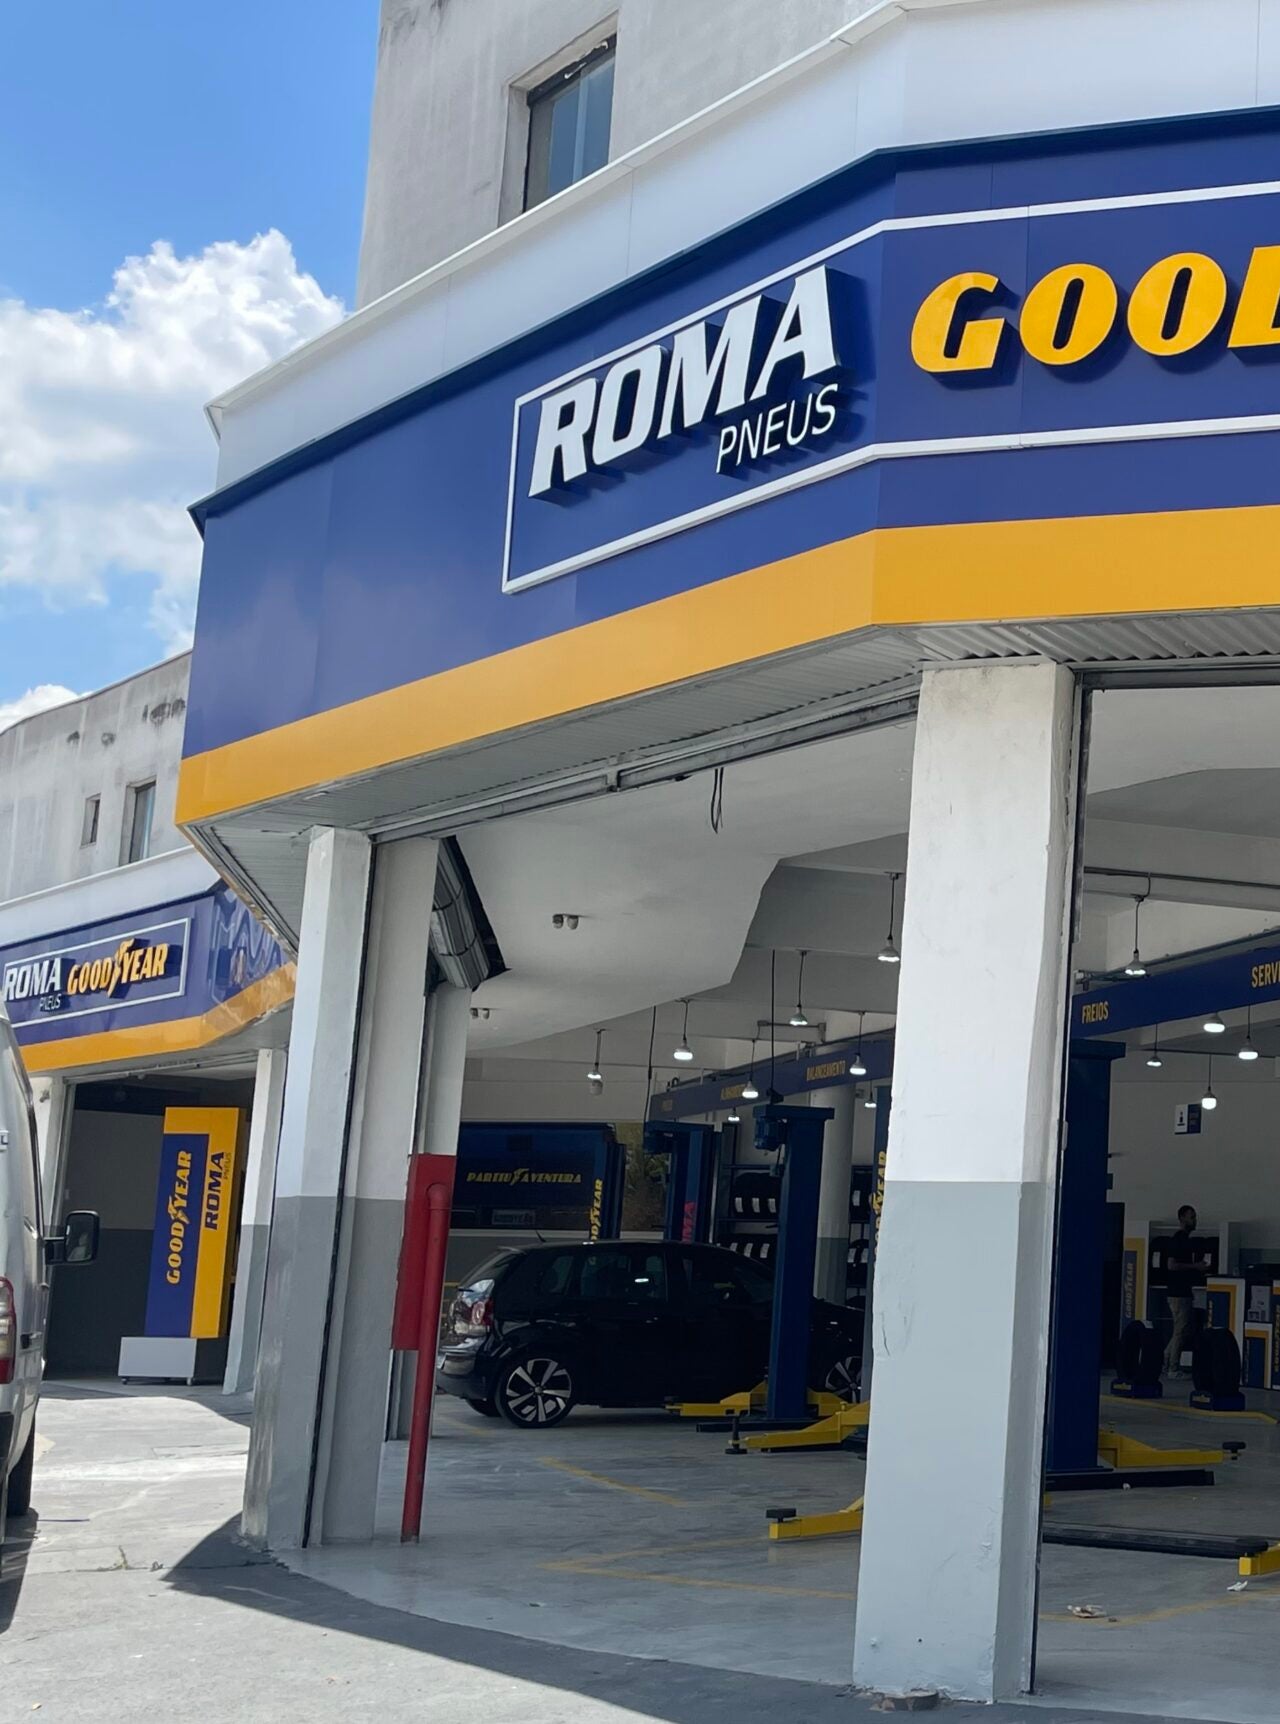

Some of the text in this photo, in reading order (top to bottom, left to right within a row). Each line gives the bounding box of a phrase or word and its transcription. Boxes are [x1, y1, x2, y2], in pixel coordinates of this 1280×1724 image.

[528, 264, 840, 497] ROMA
[716, 383, 838, 474] PNEUS
[3, 957, 62, 1001] ROMA
[1081, 1001, 1109, 1024] FREIOS
[205, 1152, 225, 1231] ROMA
